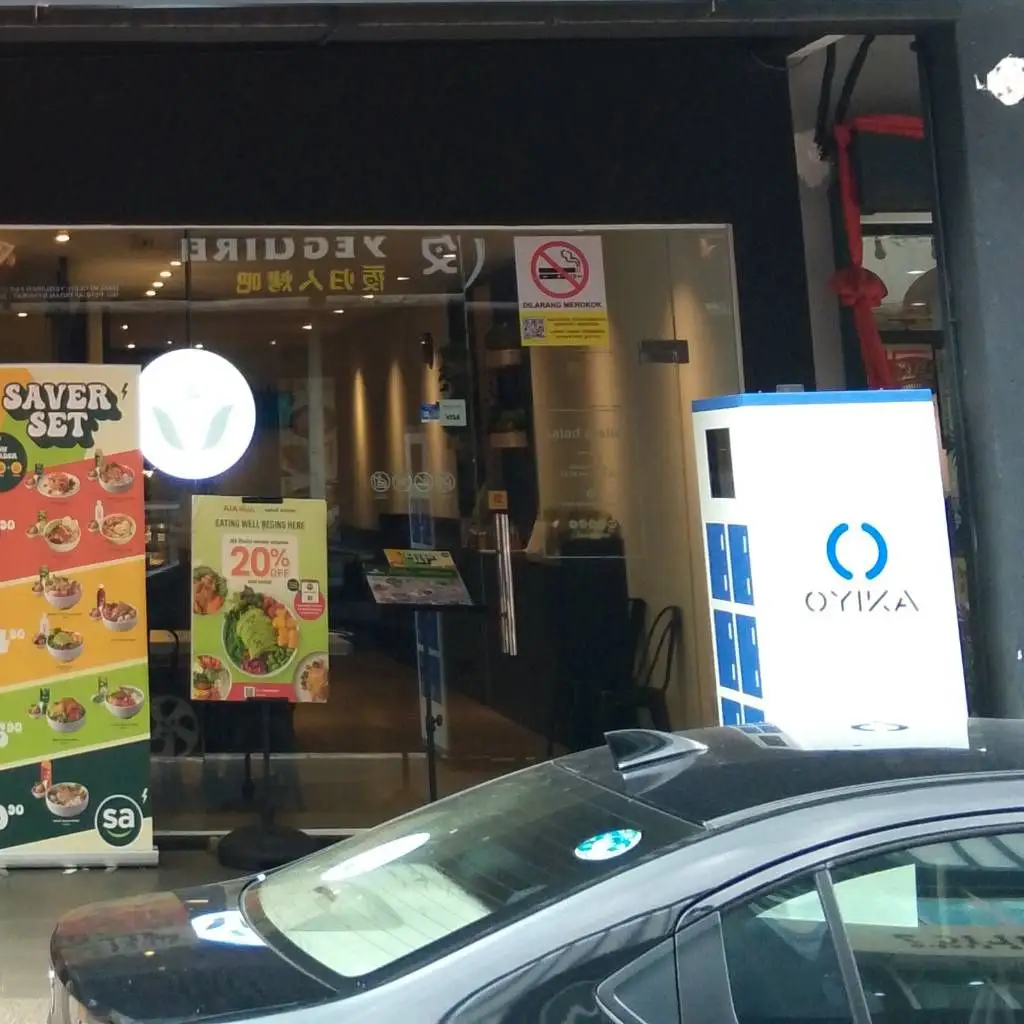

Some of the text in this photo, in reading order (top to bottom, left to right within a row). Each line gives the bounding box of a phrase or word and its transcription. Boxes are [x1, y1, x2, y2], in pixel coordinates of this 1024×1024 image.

[522, 301, 602, 309] DILARANG MEROKOK
[3, 382, 114, 412] SAVER
[27, 411, 90, 439] SET
[215, 519, 240, 529] EATING
[241, 520, 260, 529] WELL
[102, 807, 136, 829] sa
